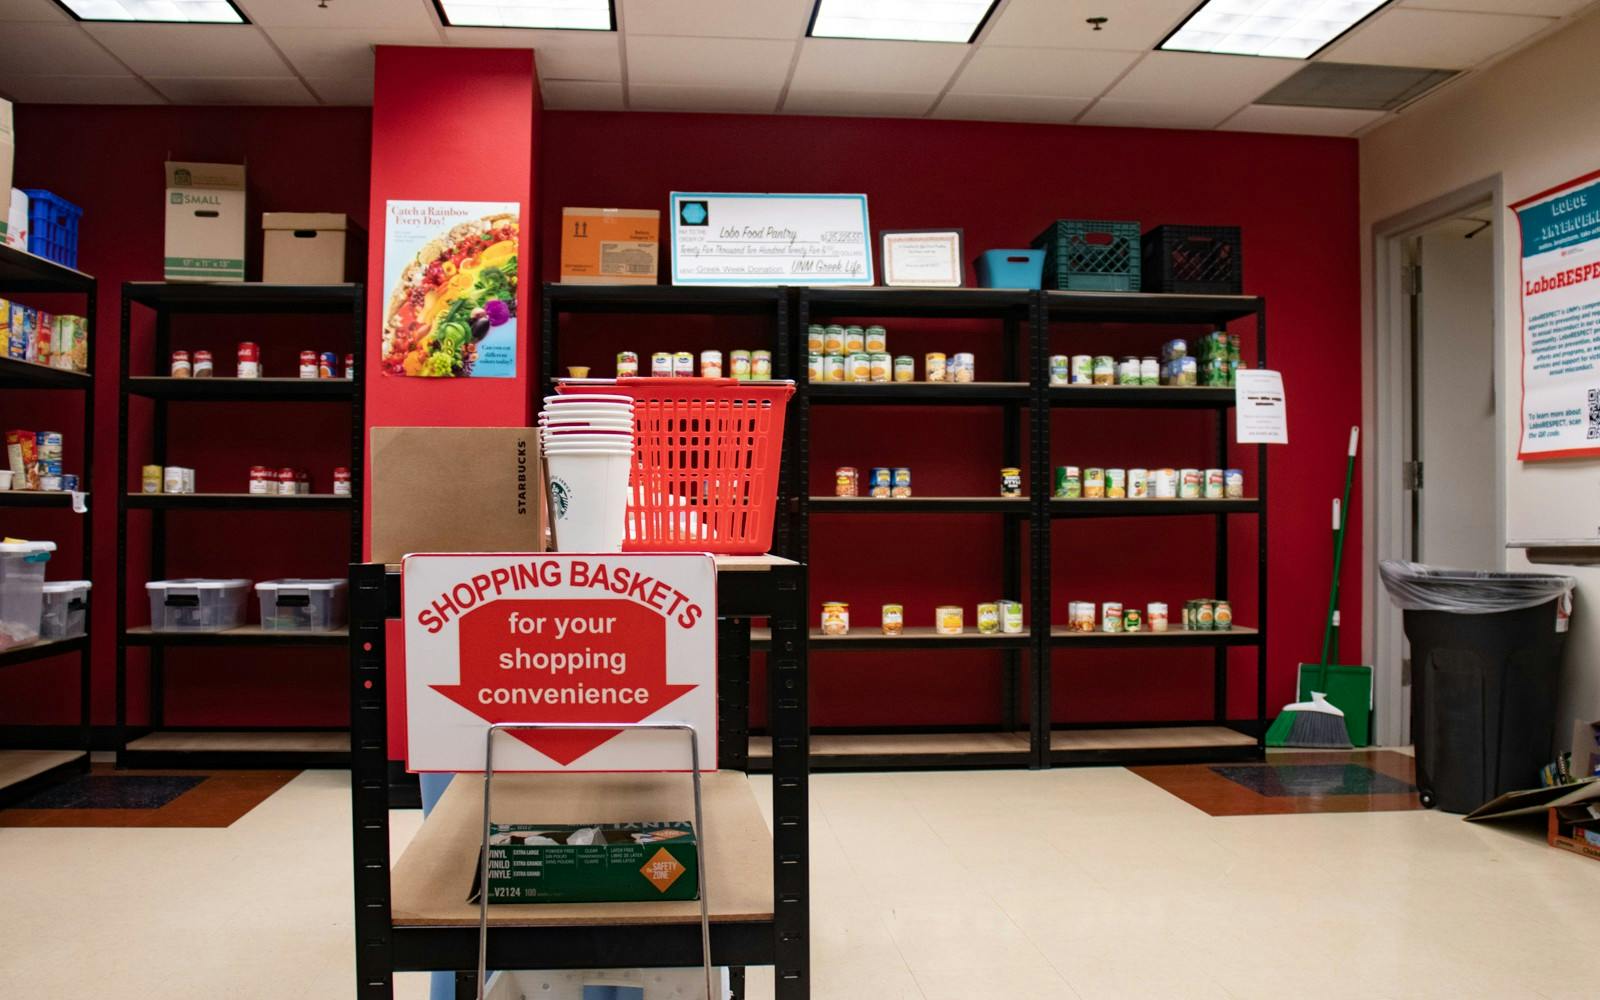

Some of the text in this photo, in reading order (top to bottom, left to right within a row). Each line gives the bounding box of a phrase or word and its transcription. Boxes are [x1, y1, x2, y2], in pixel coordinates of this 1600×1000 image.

[184, 195, 221, 205] SMALL
[391, 206, 419, 216] Catch
[427, 207, 469, 216] Rainbow
[395, 215, 445, 228] Every Day!
[719, 226, 797, 248] Lobo Food Pantry
[791, 259, 862, 277] UNM Greek Life
[1525, 260, 1600, 297] LoboRESPE
[1565, 408, 1581, 416] about
[517, 440, 526, 515] STARBUCKS
[417, 560, 702, 635] SHOPPING BASKETS
[508, 611, 617, 640] for your
[499, 647, 626, 674] shopping
[477, 682, 649, 705] convenience
[488, 849, 507, 858] VINYL
[652, 862, 677, 871] SAFETY
[652, 871, 669, 880] ZONE
[494, 887, 520, 897] V2124
[525, 888, 537, 897] 100
